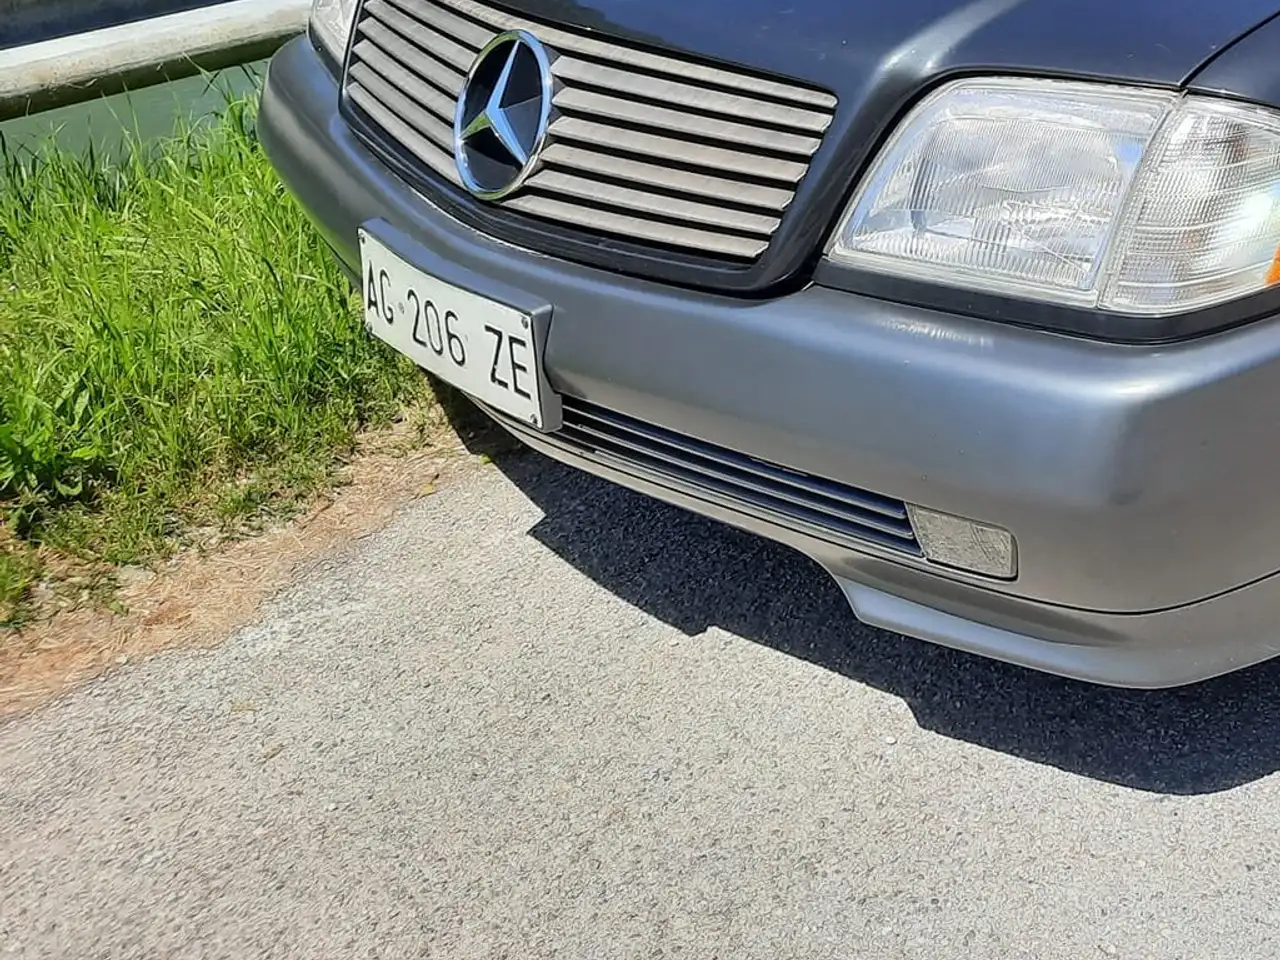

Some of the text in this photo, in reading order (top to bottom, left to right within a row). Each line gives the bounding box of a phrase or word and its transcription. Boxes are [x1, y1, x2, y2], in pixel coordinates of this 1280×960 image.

[367, 260, 532, 400] AG 206 ZE
